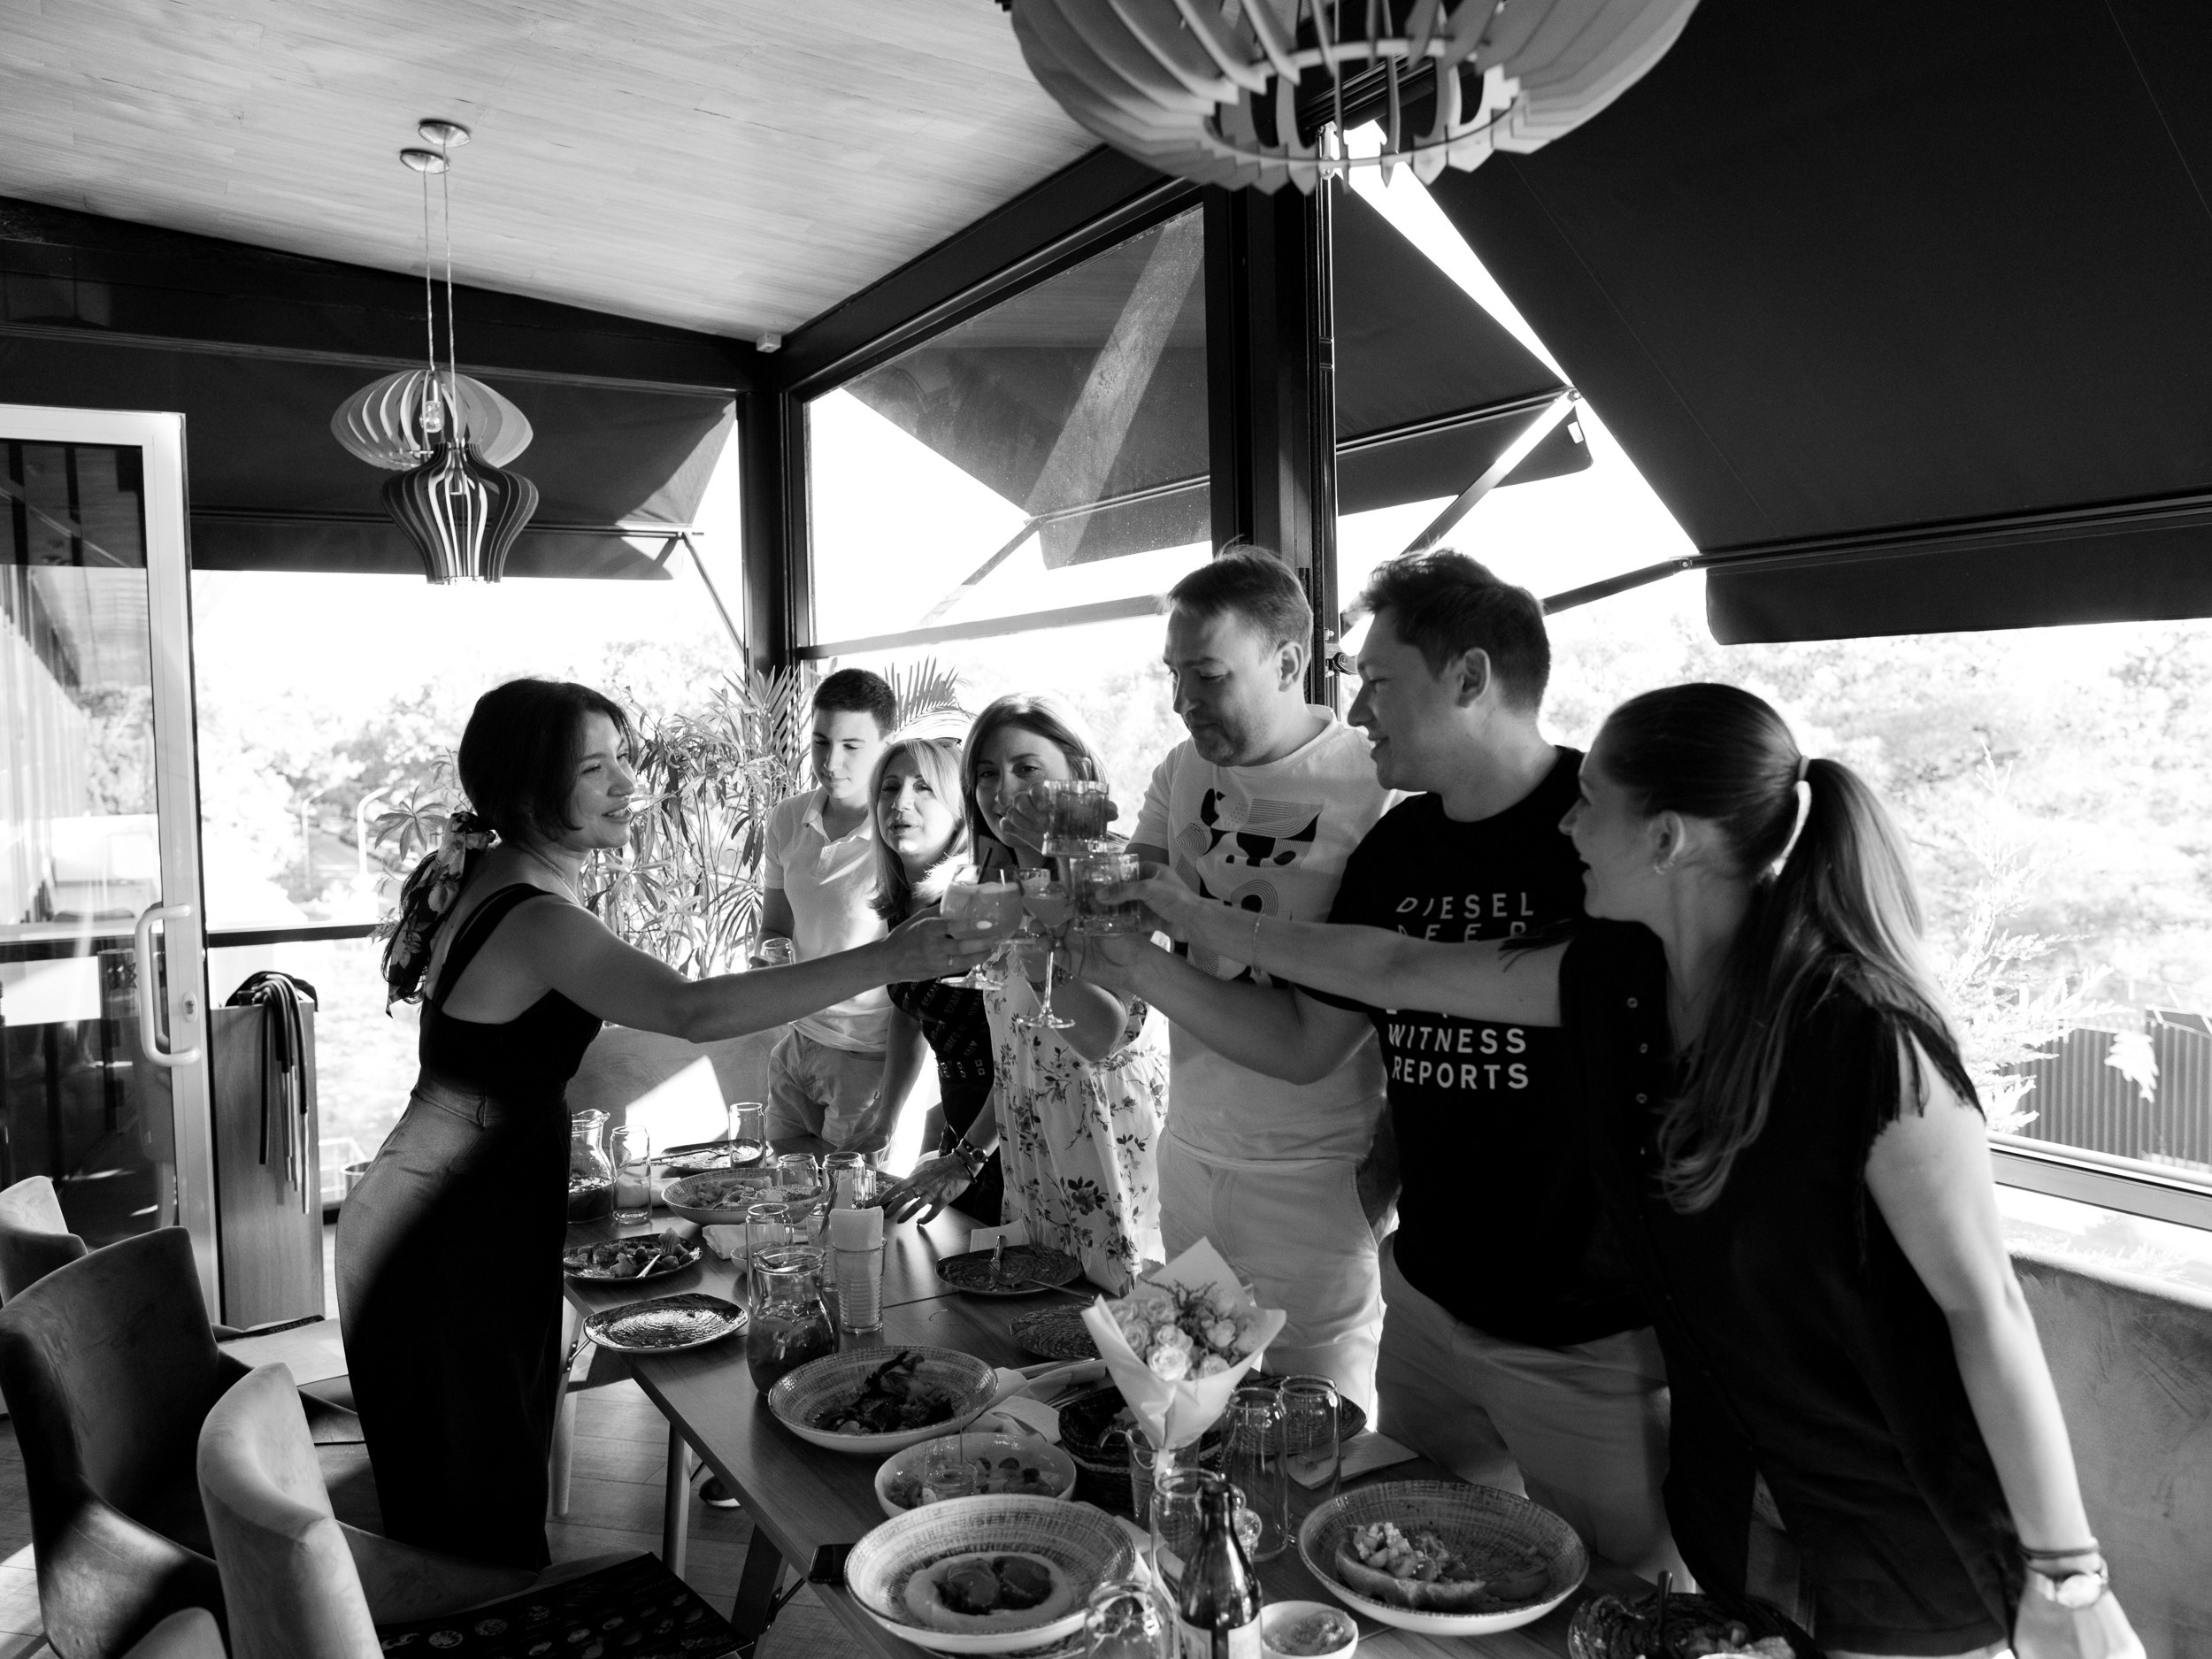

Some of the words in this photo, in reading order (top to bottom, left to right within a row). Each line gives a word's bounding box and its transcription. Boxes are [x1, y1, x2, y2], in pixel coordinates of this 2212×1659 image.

[1395, 892, 1533, 919] DIESEL
[1388, 1024, 1526, 1054] WITNESS
[1392, 1056, 1529, 1089] REPORTS
